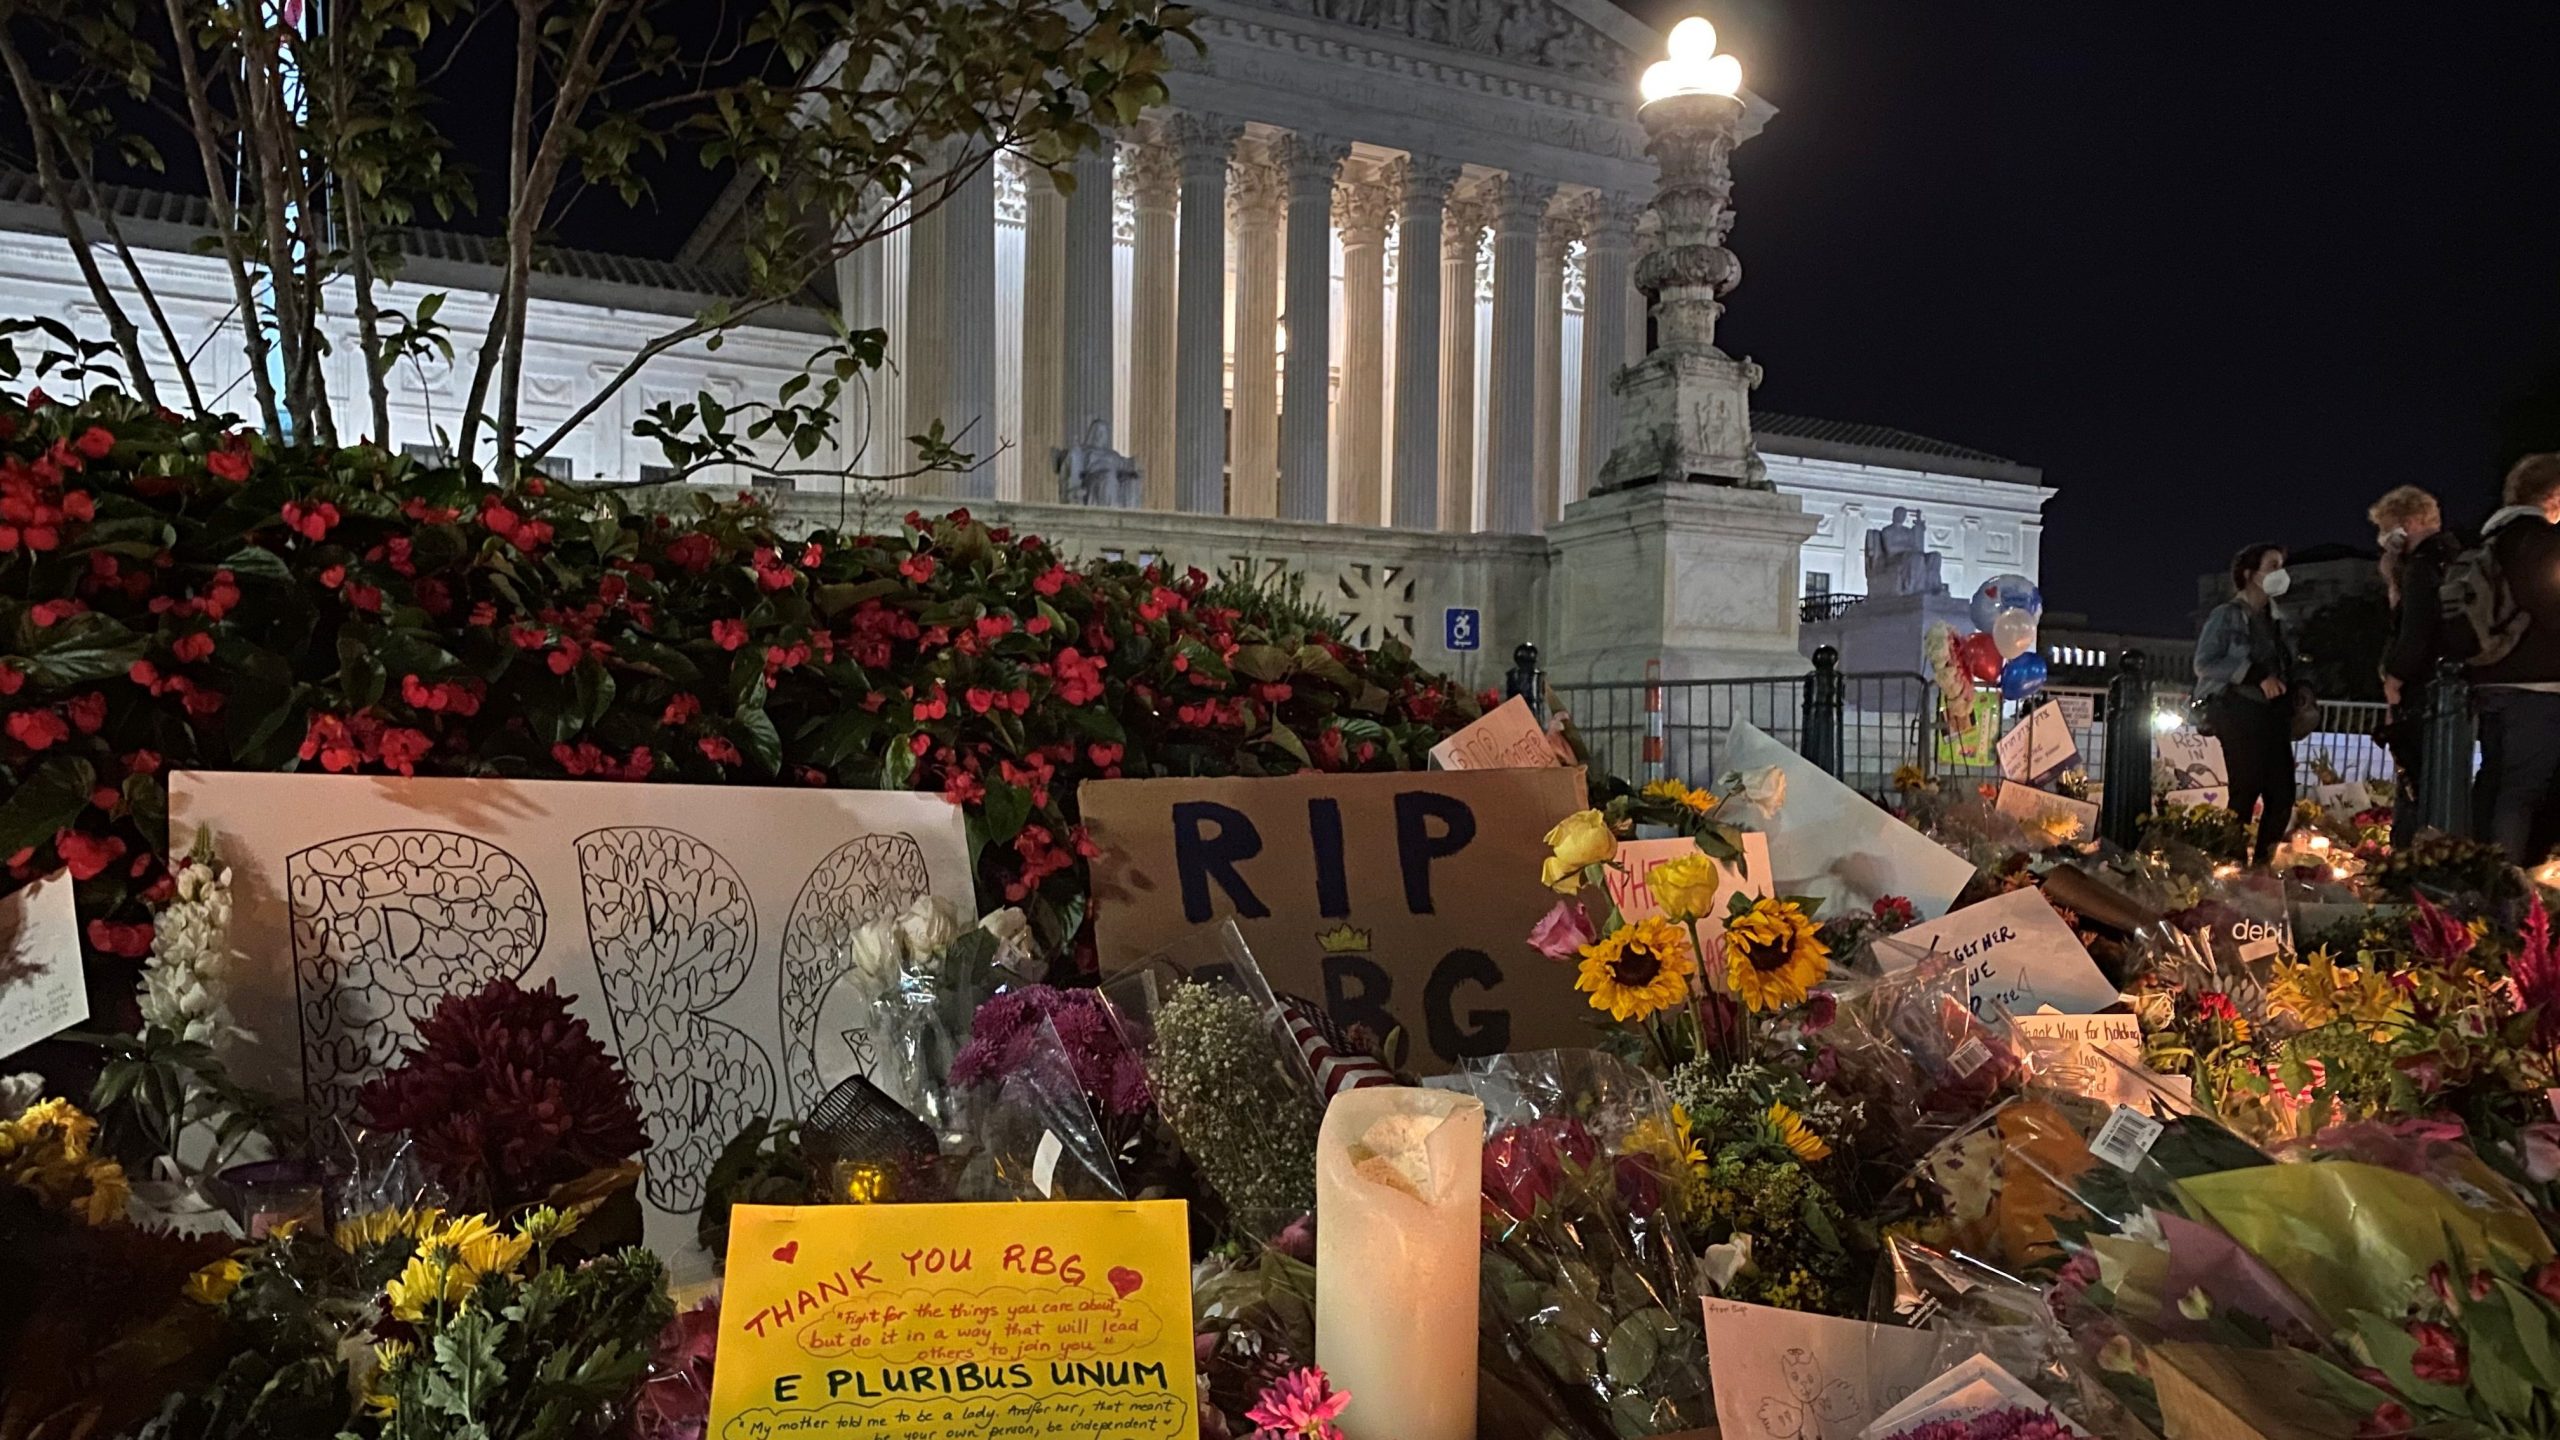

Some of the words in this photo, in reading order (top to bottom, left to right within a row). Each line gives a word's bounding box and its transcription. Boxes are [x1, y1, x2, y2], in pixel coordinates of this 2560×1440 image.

[2172, 731, 2208, 748] REST
[2188, 749, 2204, 760] IN
[1172, 790, 1476, 923] RIP
[2232, 918, 2283, 944] debi
[1969, 961, 1996, 986] WE
[1193, 949, 1511, 1072] BG
[2085, 1020, 2099, 1039] for
[2104, 1021, 2140, 1048] holding
[744, 1260, 883, 1338] THANK
[901, 1247, 972, 1277] YOU
[1003, 1244, 1086, 1287] RBG
[881, 1305, 908, 1328] for
[914, 1303, 945, 1318] the
[950, 1303, 999, 1325] things
[1007, 1305, 1038, 1321] you
[1042, 1302, 1074, 1312] care
[1078, 1298, 1123, 1318] about,
[809, 1330, 846, 1349] but
[850, 1334, 872, 1347] do
[881, 1329, 899, 1345] it
[906, 1329, 926, 1342] in
[933, 1328, 948, 1340] a
[957, 1329, 992, 1346] way
[1004, 1320, 1045, 1337] that
[1057, 1317, 1089, 1336] will
[1102, 1319, 1139, 1333] lead
[917, 1345, 975, 1361] others
[989, 1341, 1009, 1356] to
[1010, 1341, 1052, 1362] join
[774, 1375, 802, 1402] E
[826, 1361, 1034, 1399] PLURIBUS
[1050, 1361, 1168, 1390] UNUM
[778, 1415, 830, 1431] mother
[836, 1415, 863, 1429] told
[867, 1418, 888, 1428] me
[895, 1409, 911, 1423] to
[917, 1409, 933, 1421] be
[943, 1411, 953, 1421] a
[1093, 1400, 1124, 1413] that
[1129, 1400, 1175, 1413] meant
[903, 1430, 938, 1440] your
[946, 1429, 979, 1439] own
[988, 1424, 1040, 1440] person,
[1047, 1420, 1064, 1433] be
[1070, 1416, 1158, 1440] independent
